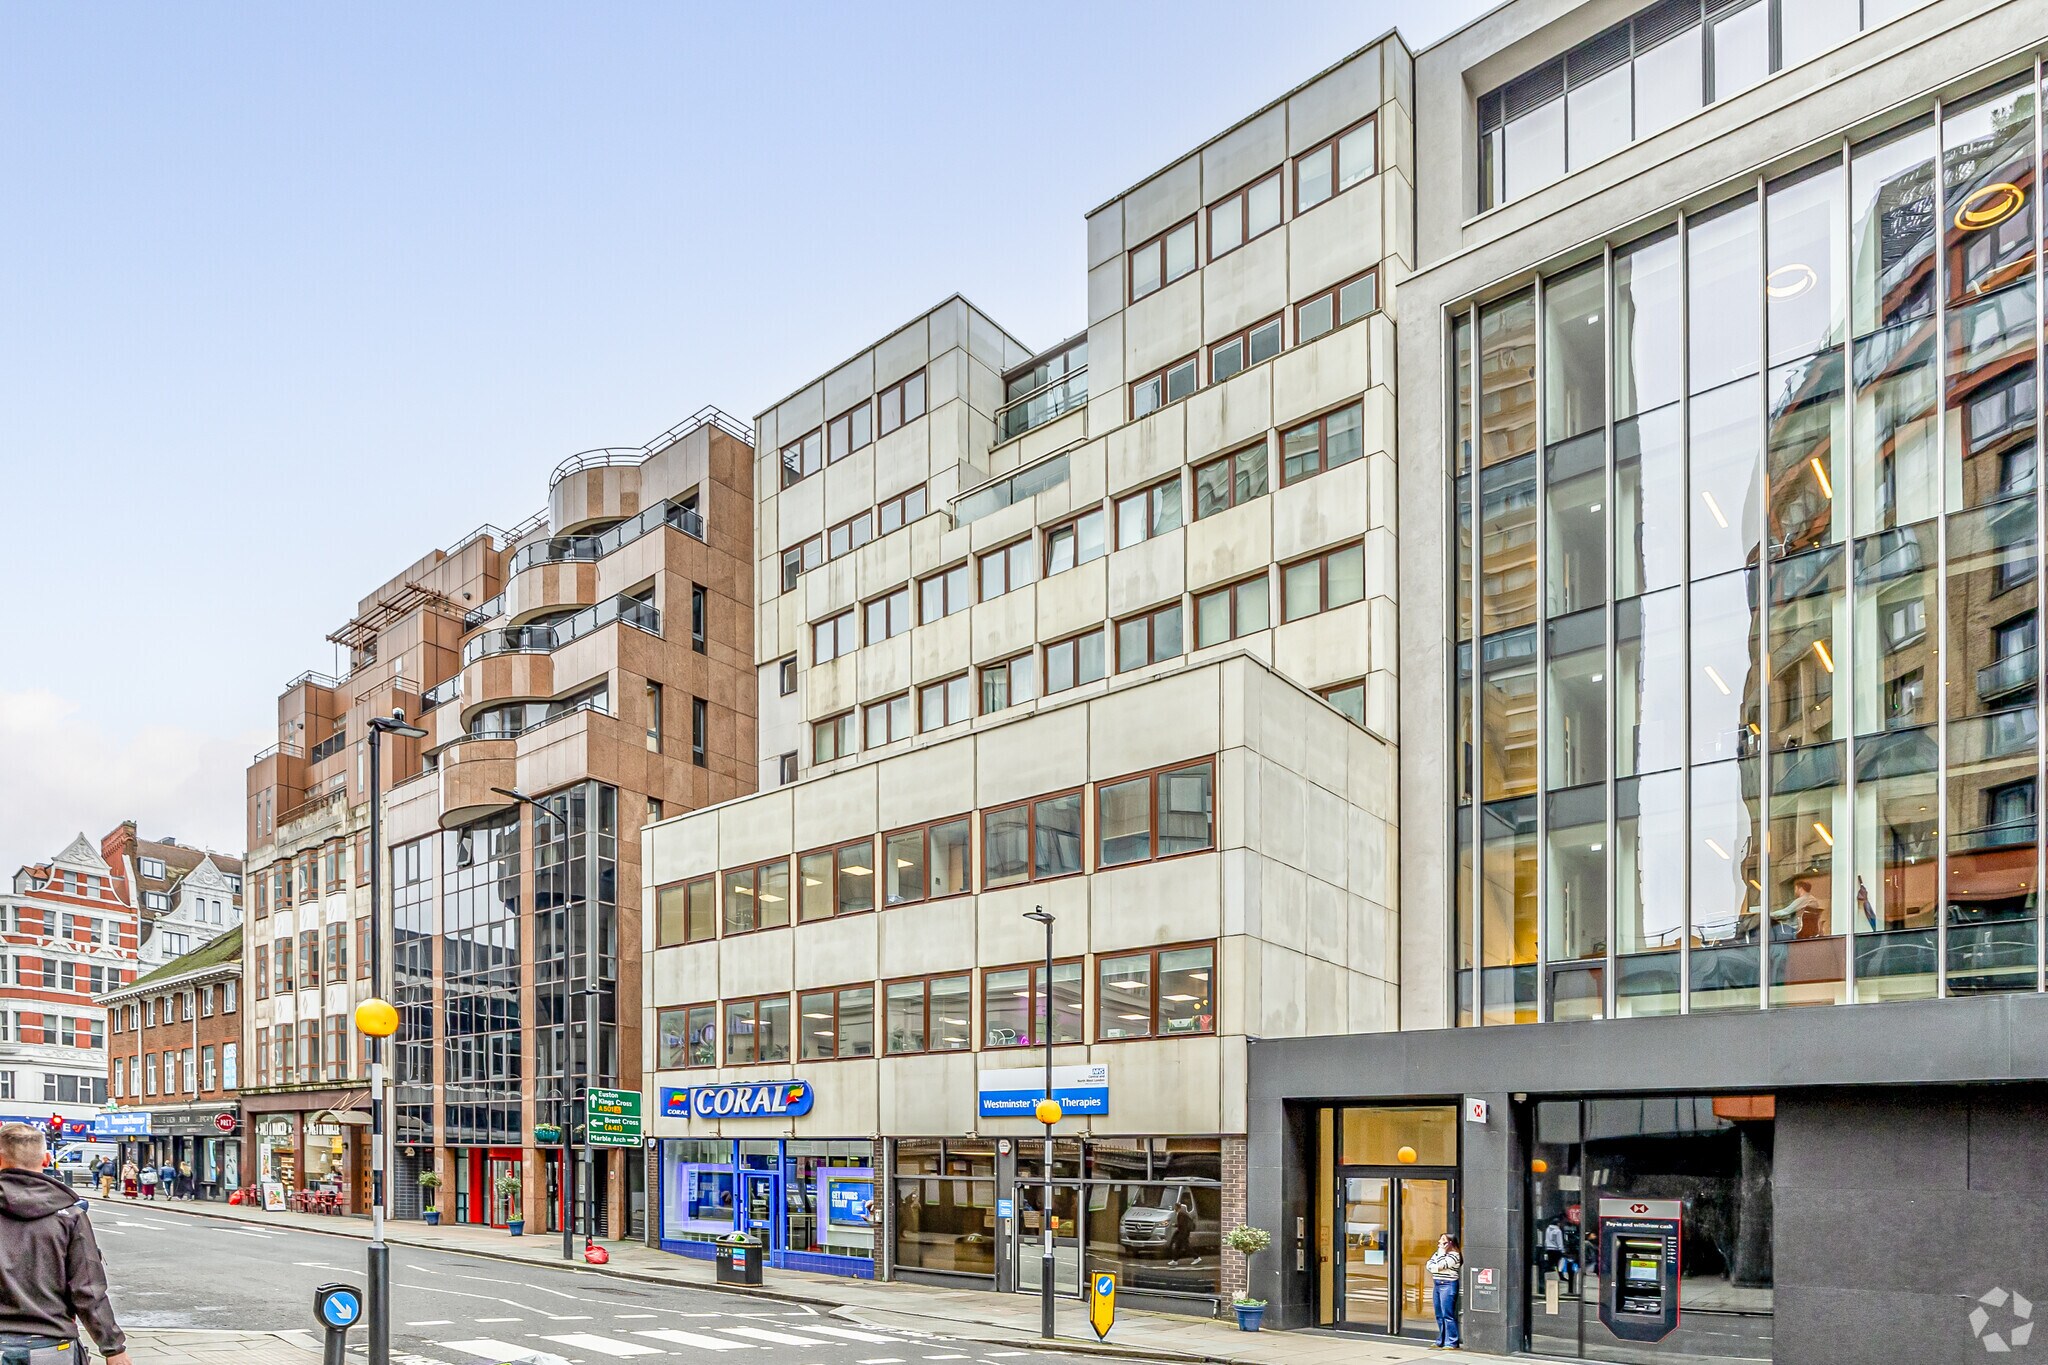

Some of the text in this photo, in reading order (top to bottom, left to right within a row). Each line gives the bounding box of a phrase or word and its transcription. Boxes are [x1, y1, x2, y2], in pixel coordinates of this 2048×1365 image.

[697, 1086, 787, 1115] CORAL
[984, 1099, 1030, 1108] Westminster
[1061, 1096, 1101, 1108] Therapies
